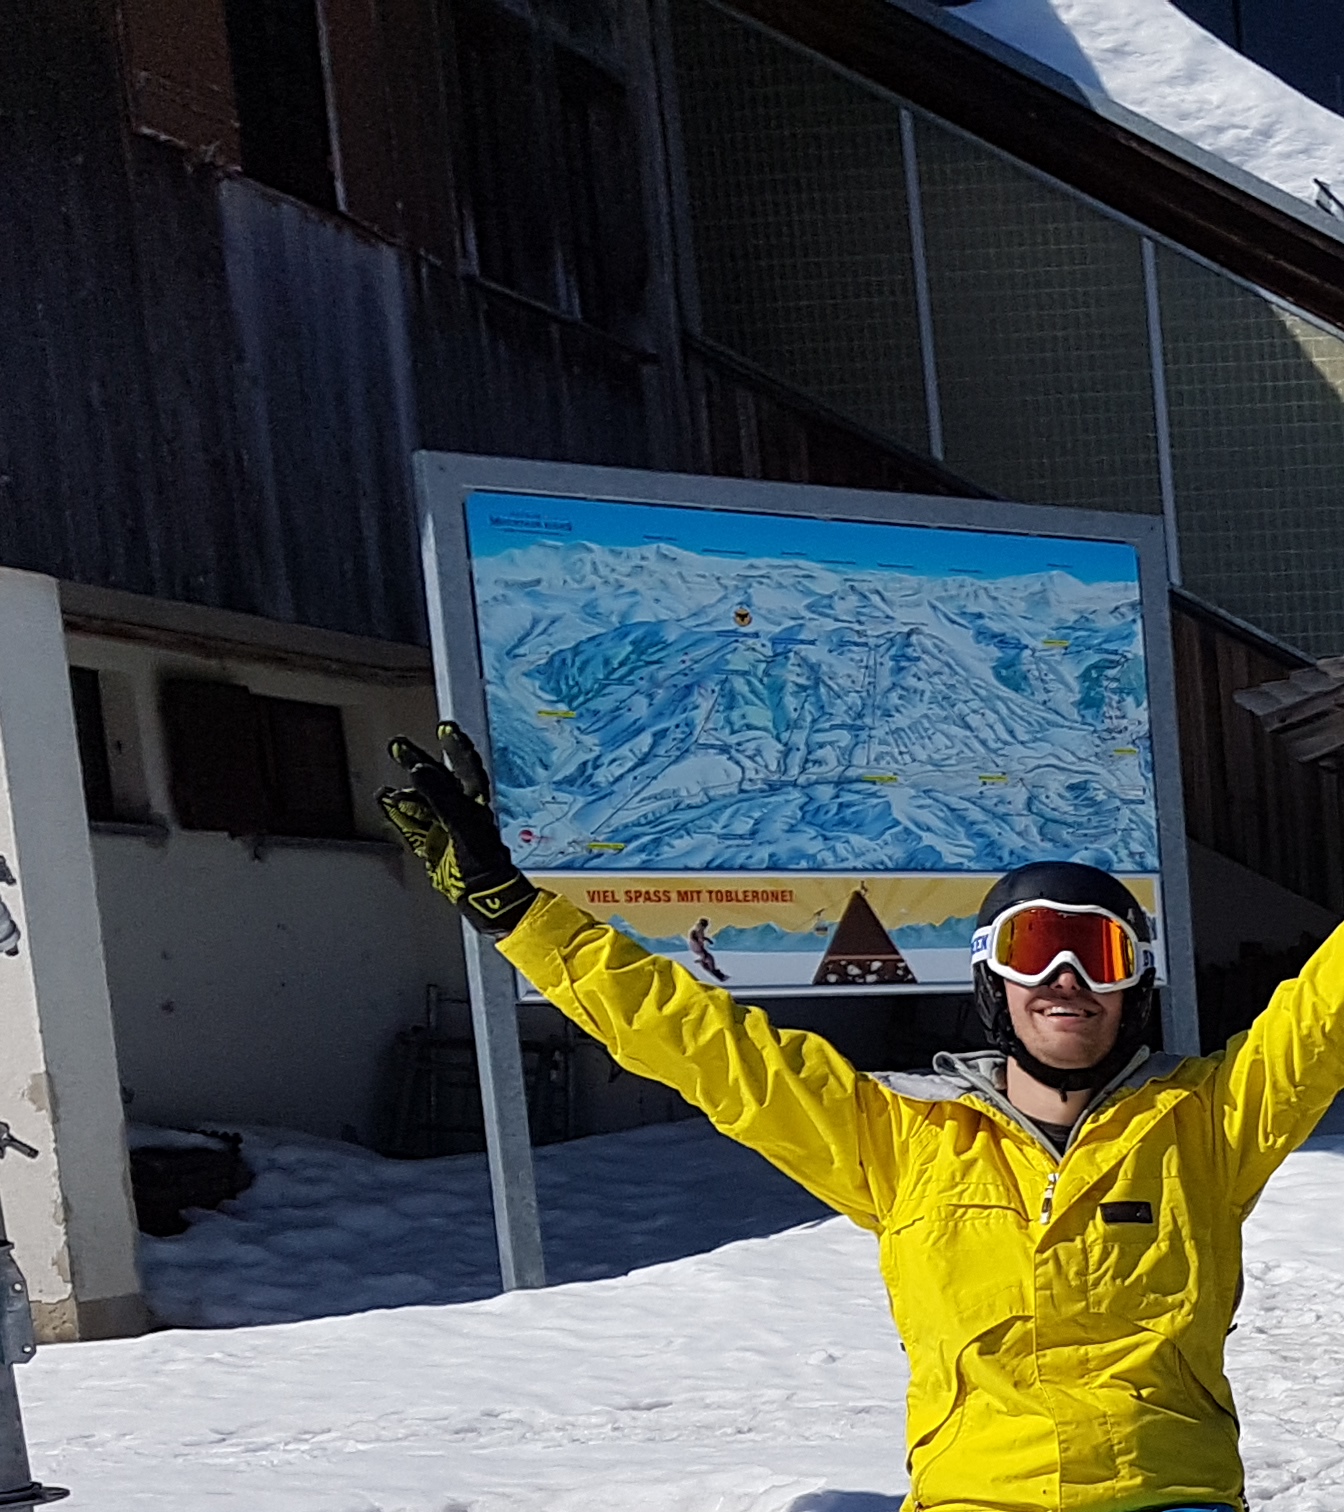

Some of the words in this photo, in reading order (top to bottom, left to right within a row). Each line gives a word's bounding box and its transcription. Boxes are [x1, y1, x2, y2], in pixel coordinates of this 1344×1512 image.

[586, 889, 620, 904] VIEL
[623, 889, 671, 904] SPASS
[676, 889, 703, 904] MIT
[706, 889, 794, 904] TOBLERONE!
